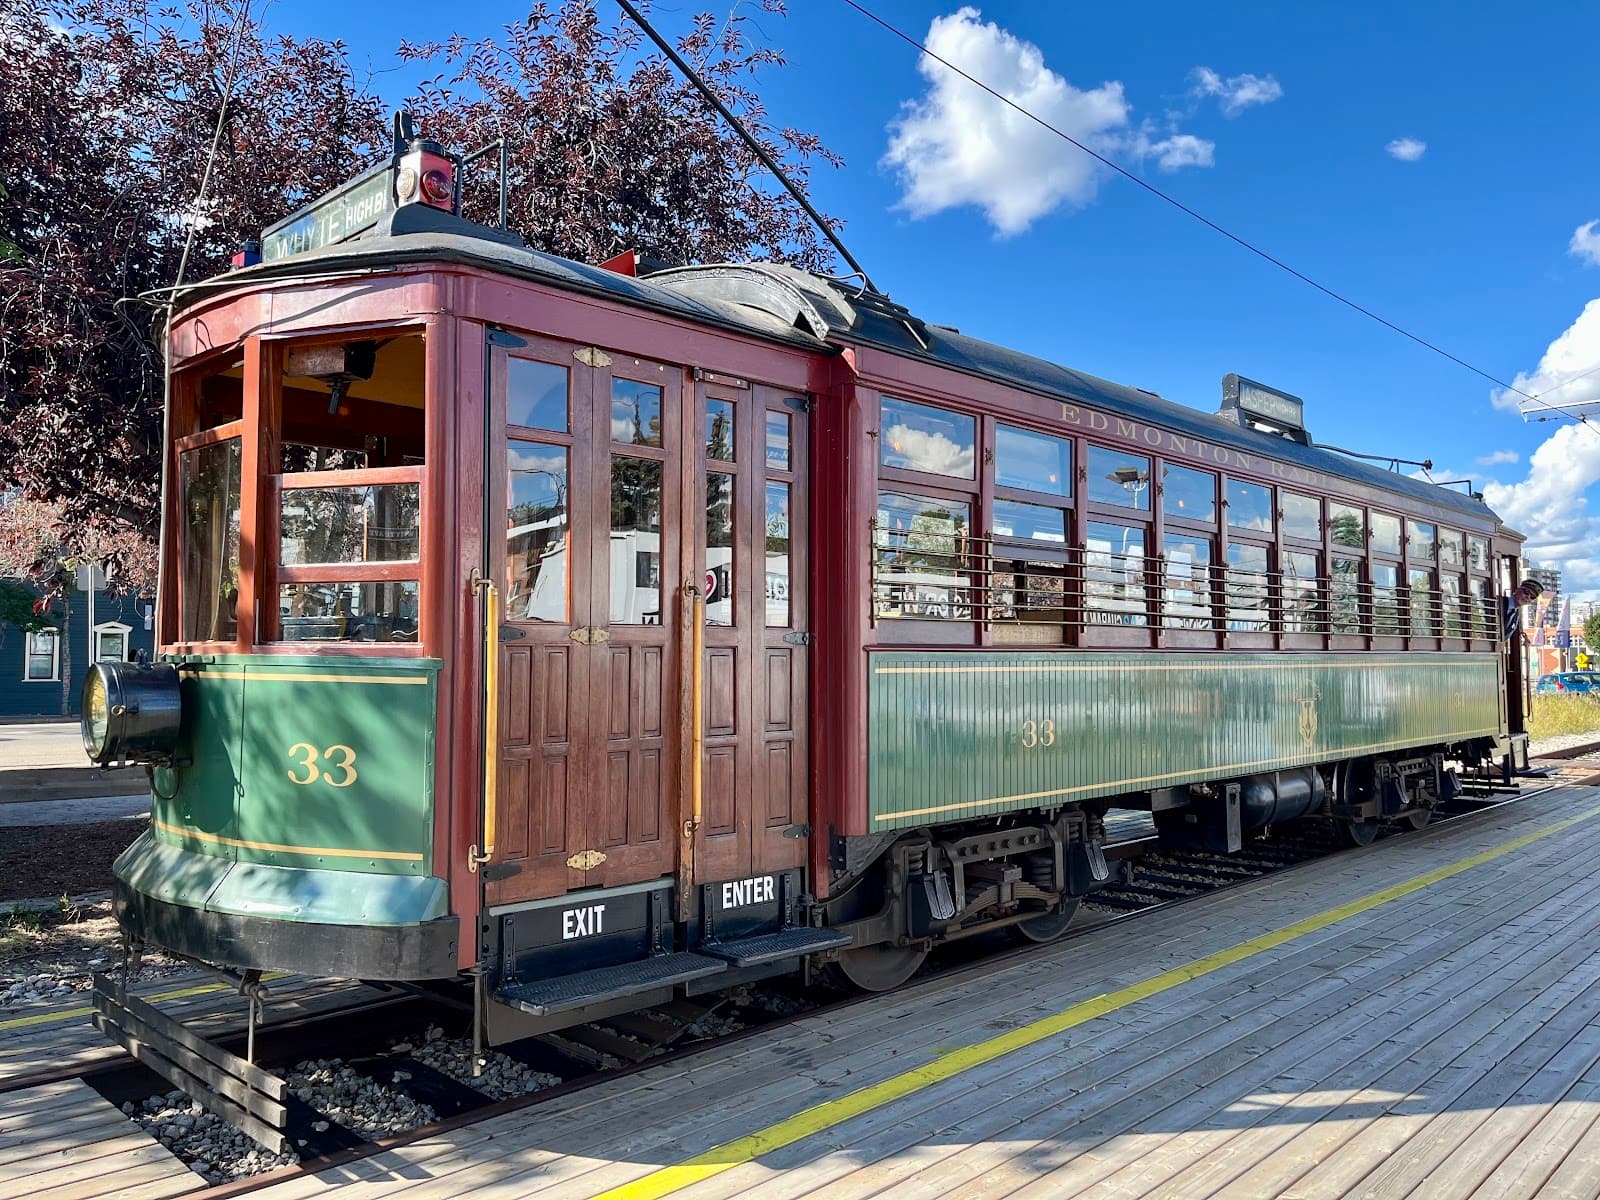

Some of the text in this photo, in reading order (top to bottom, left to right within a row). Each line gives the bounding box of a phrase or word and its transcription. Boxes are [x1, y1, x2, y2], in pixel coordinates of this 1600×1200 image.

[1060, 403, 1251, 469] EDMONTON
[1270, 461, 1330, 489] RADI
[1022, 719, 1055, 748] 33
[287, 742, 358, 788] 33
[722, 875, 775, 909] ENTER
[562, 904, 605, 940] EXIT
